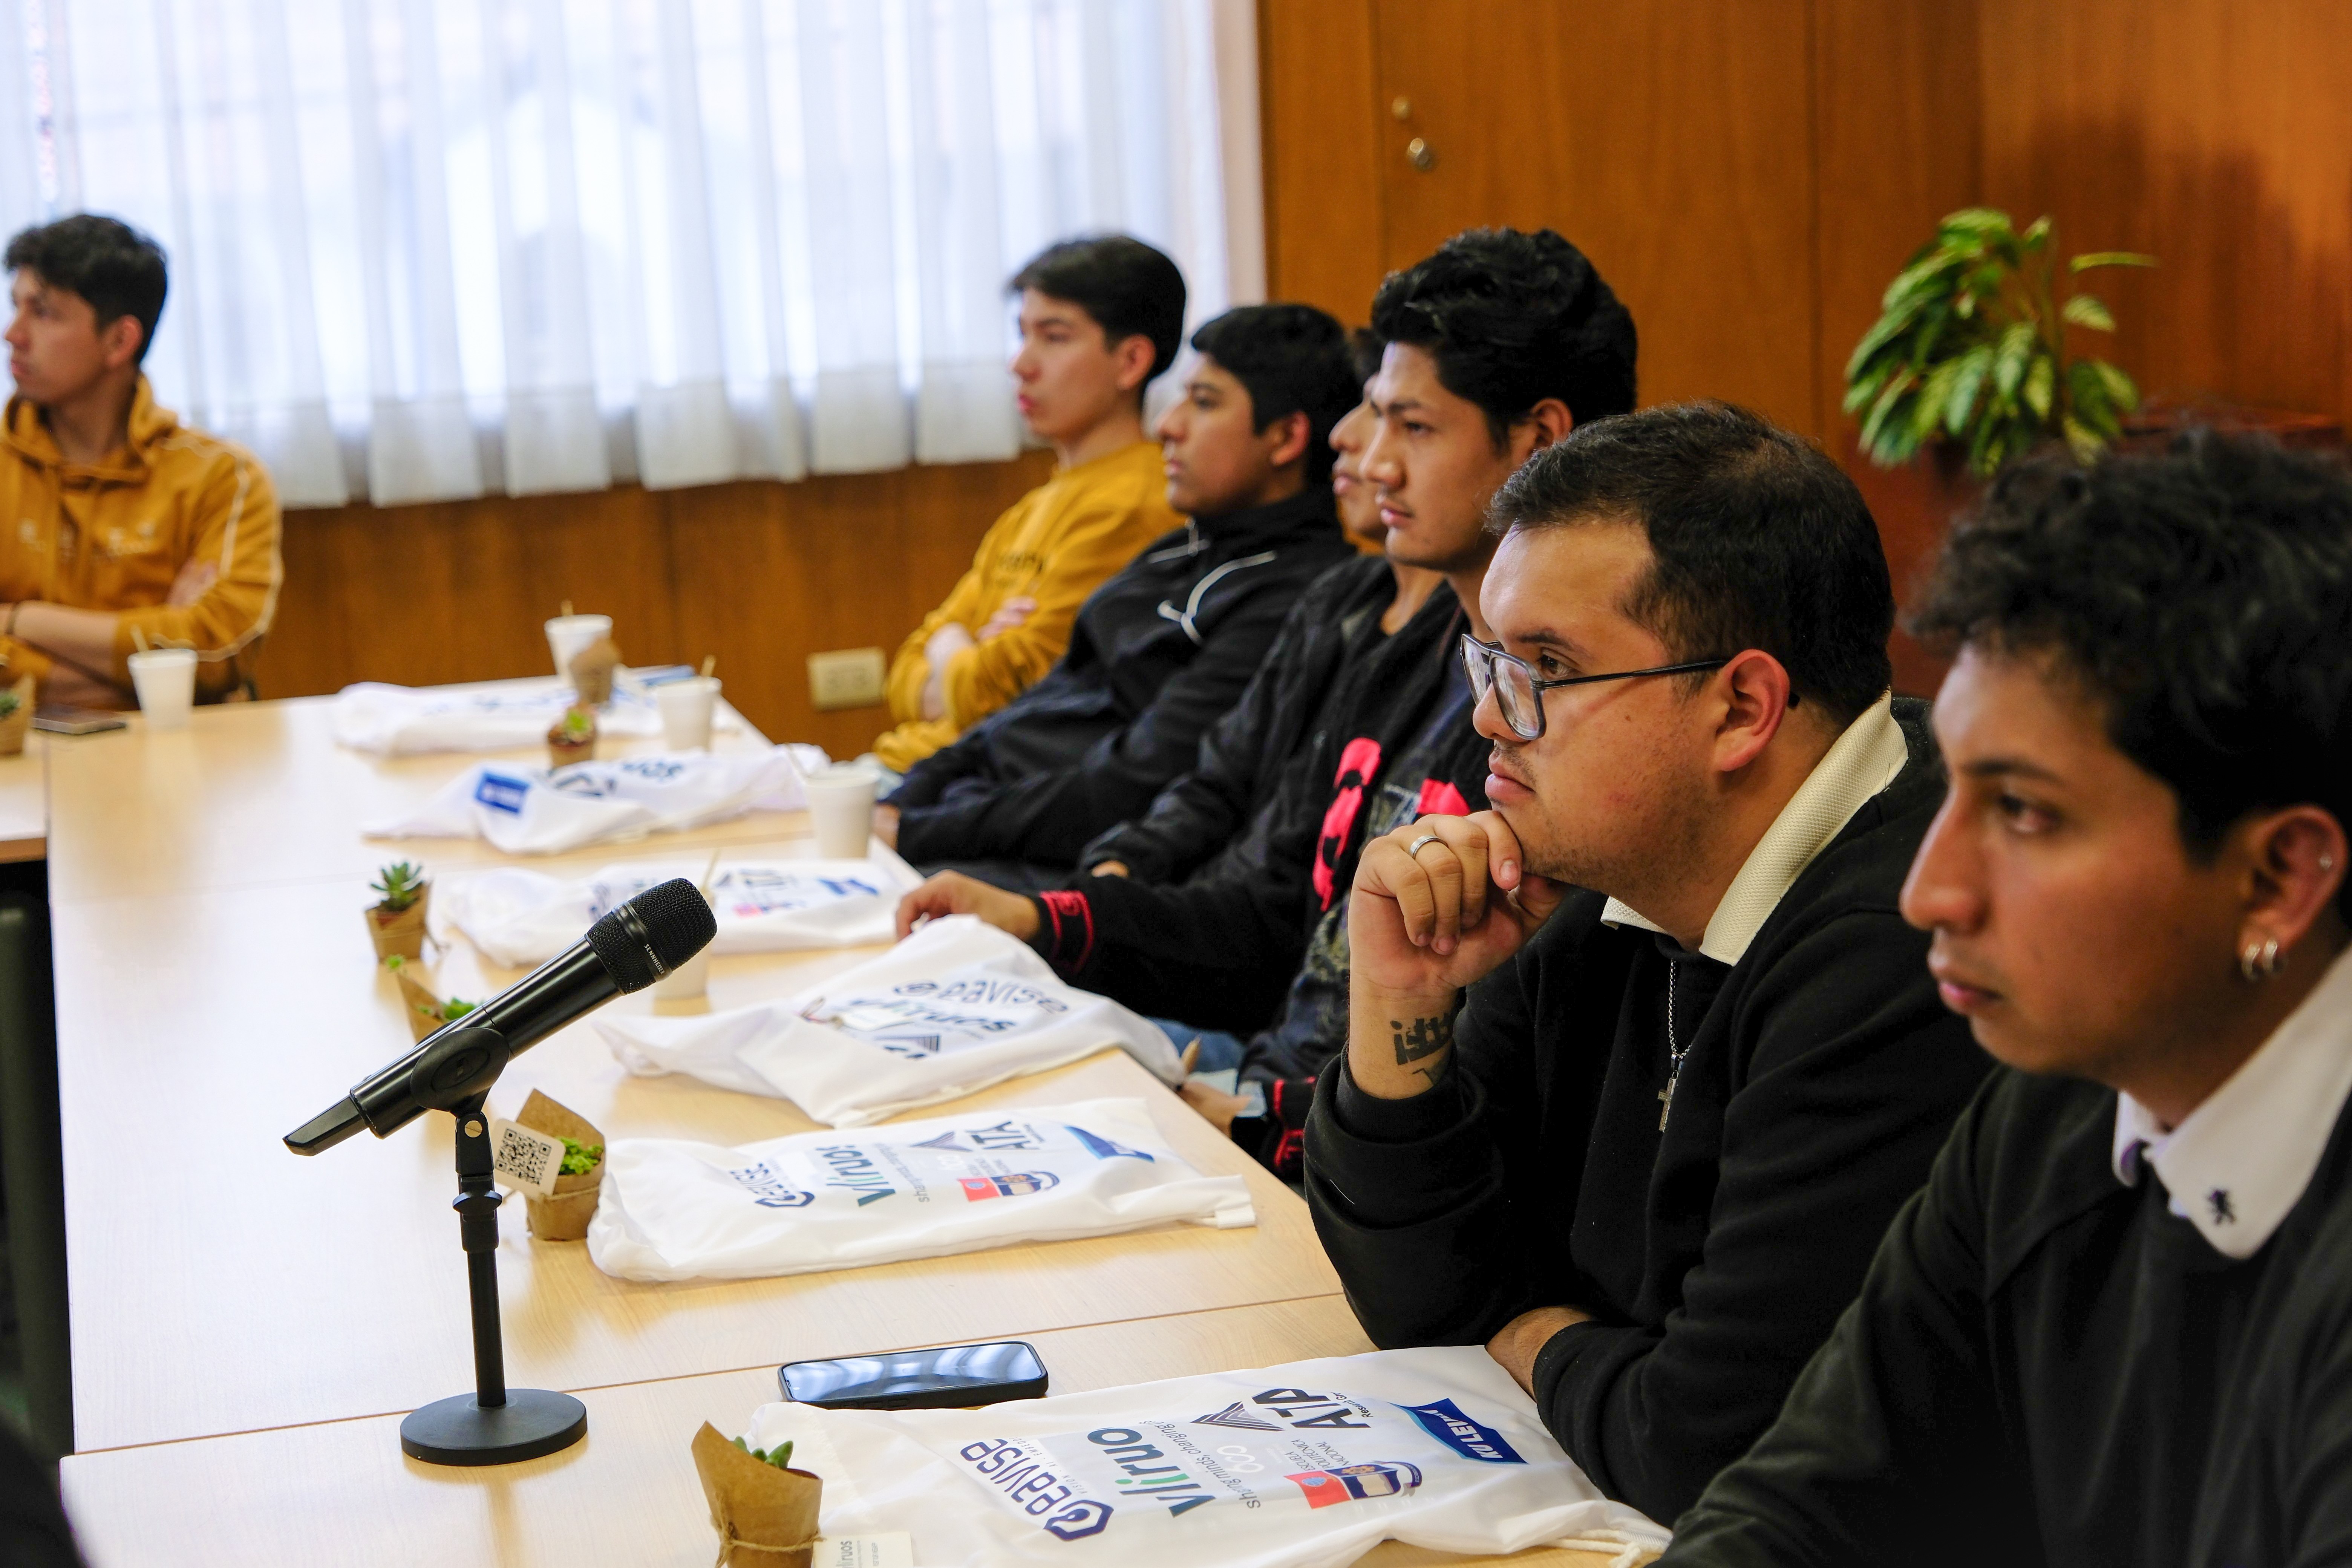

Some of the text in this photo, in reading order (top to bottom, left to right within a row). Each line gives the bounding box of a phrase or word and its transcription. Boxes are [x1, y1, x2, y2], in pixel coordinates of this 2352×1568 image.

[644, 943, 665, 974] SENNHEISER
[1342, 1400, 1374, 1418] Research
[1154, 1424, 1202, 1454] changing
[1467, 1444, 1504, 1458] KU
[1285, 1451, 1316, 1471] ESCUELA
[1290, 1439, 1335, 1469] POLITÉCNICA
[1315, 1441, 1353, 1466] NACIONAL
[1087, 1427, 1217, 1518] vliruo
[1195, 1454, 1231, 1479] minds,
